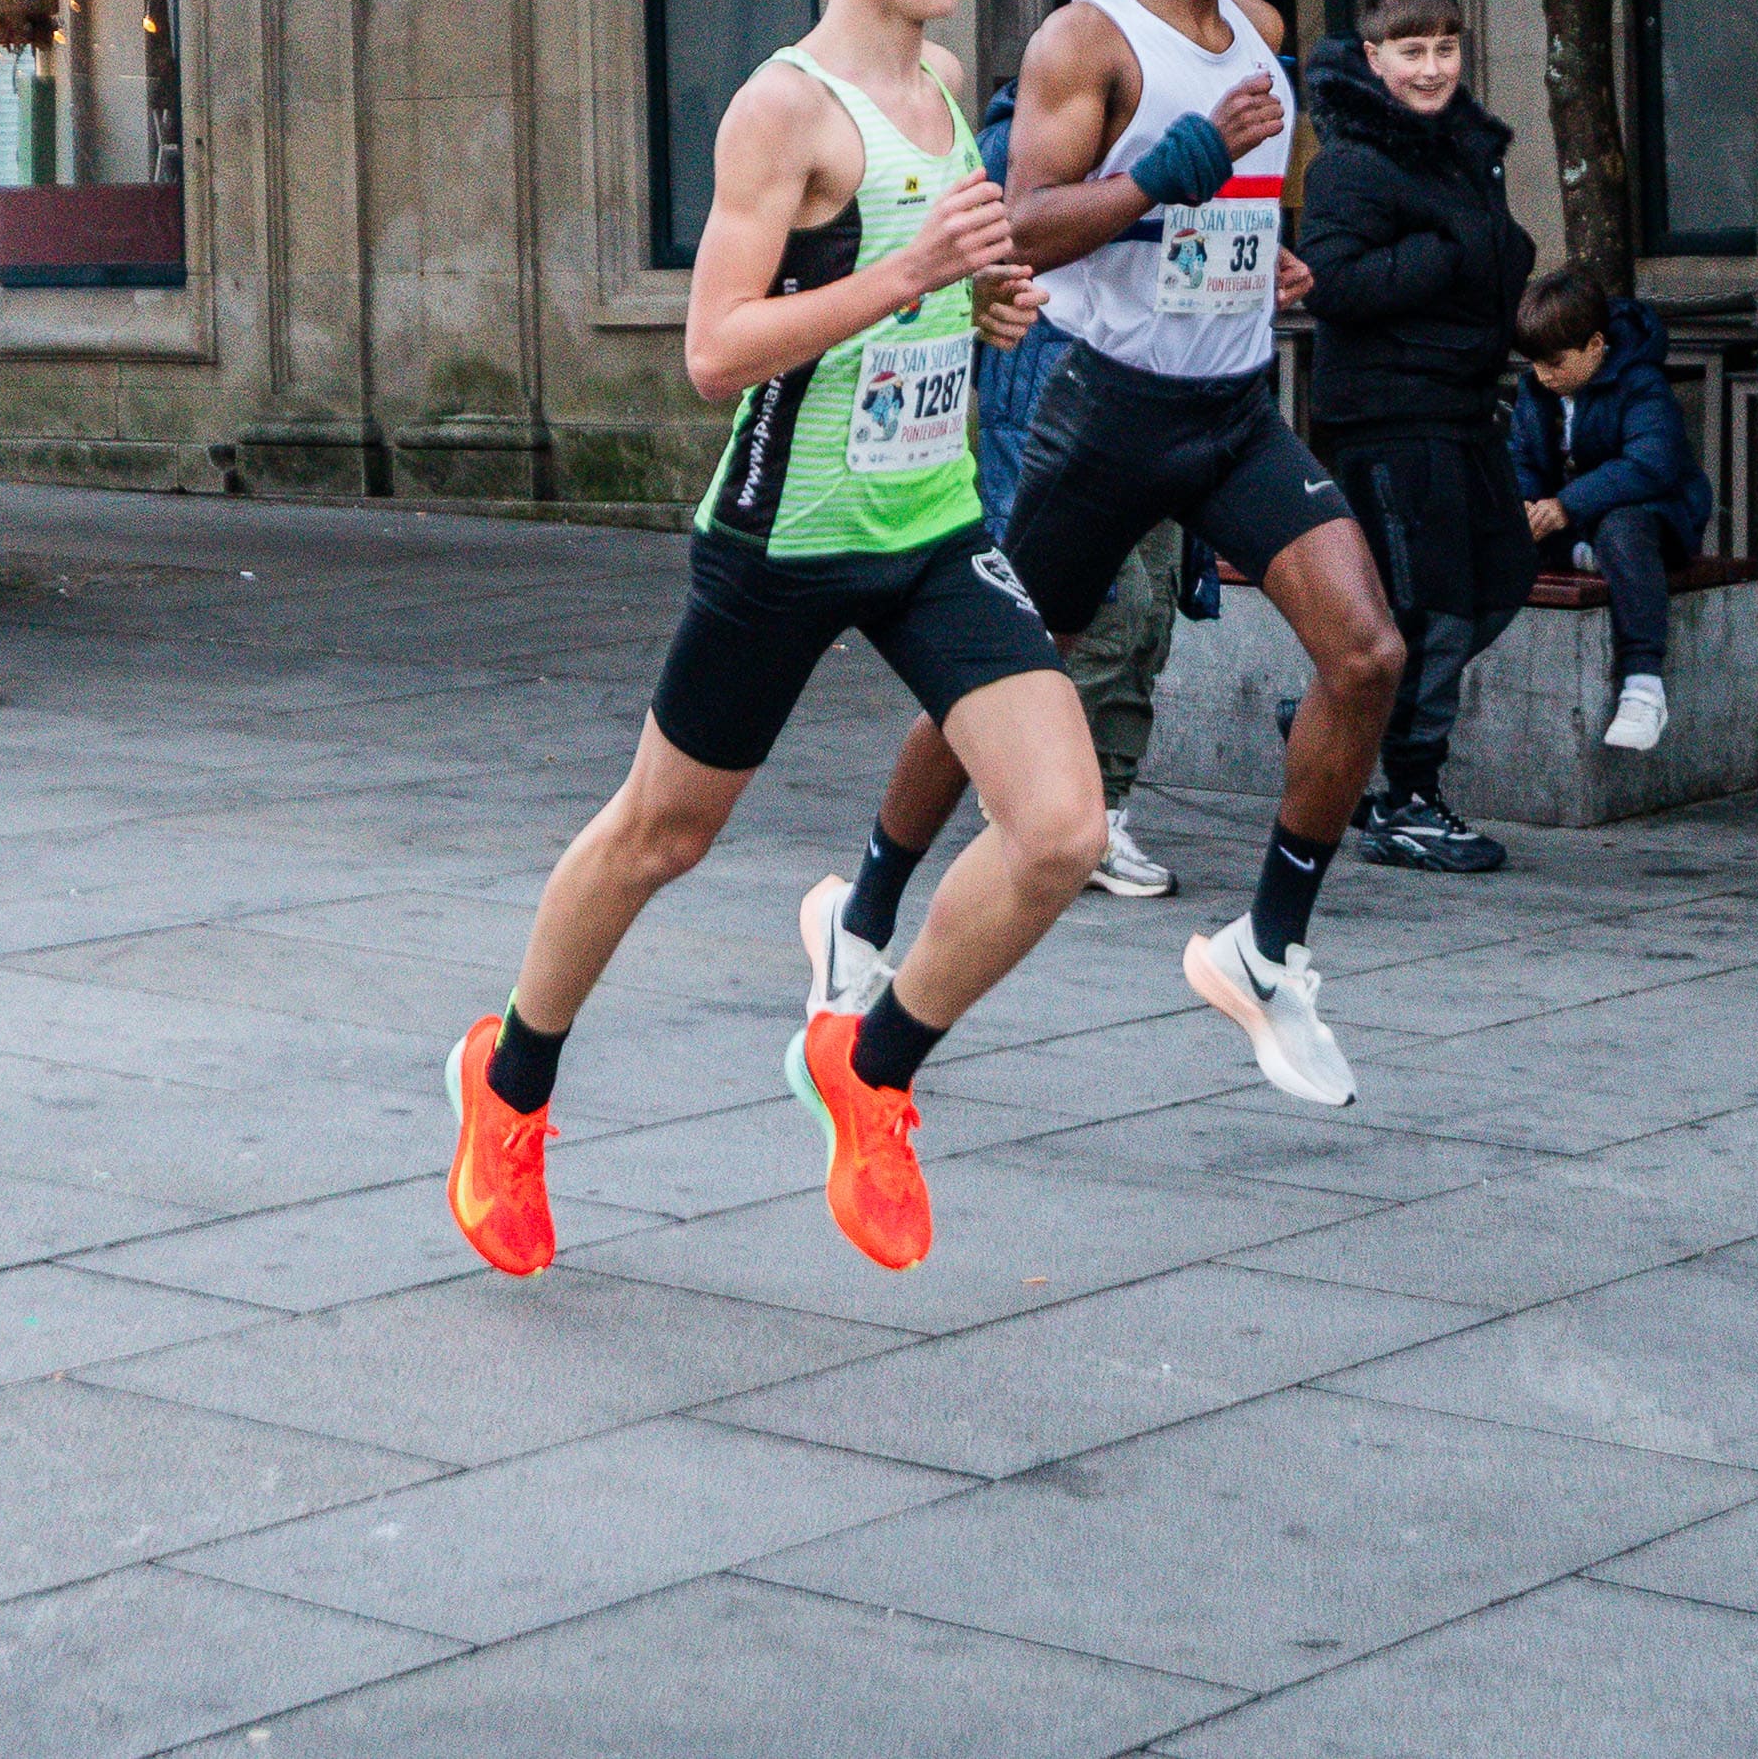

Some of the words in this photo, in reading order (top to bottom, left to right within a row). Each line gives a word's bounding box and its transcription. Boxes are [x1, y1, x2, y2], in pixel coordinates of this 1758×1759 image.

[1199, 209, 1226, 231] SAN
[1230, 234, 1259, 272] 33
[902, 345, 928, 374] SAN
[914, 365, 966, 419] 1287
